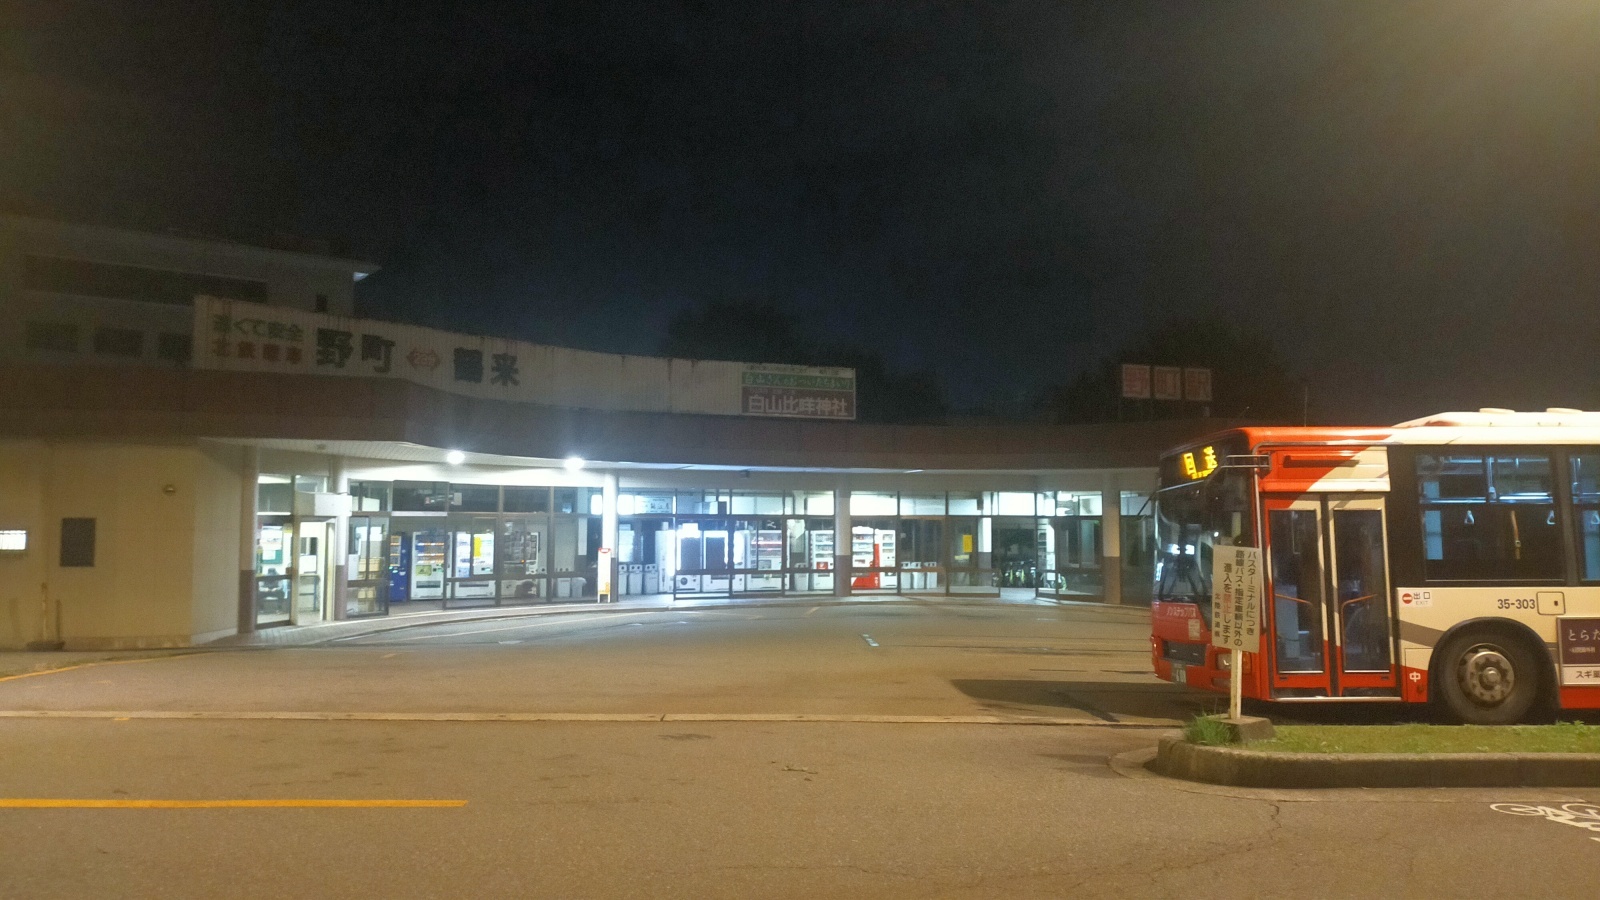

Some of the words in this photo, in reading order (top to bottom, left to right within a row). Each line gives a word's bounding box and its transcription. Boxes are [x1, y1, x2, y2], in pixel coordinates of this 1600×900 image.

[316, 327, 396, 373] 野町
[748, 394, 848, 416] 白山比咩神社
[1183, 446, 1218, 475] 回送
[1222, 562, 1233, 644] 進入を禁止します
[1245, 550, 1257, 636] バスターミナルにつき
[1413, 591, 1431, 600] 出口
[1497, 598, 1536, 610] 35-303
[1409, 671, 1421, 683] 中
